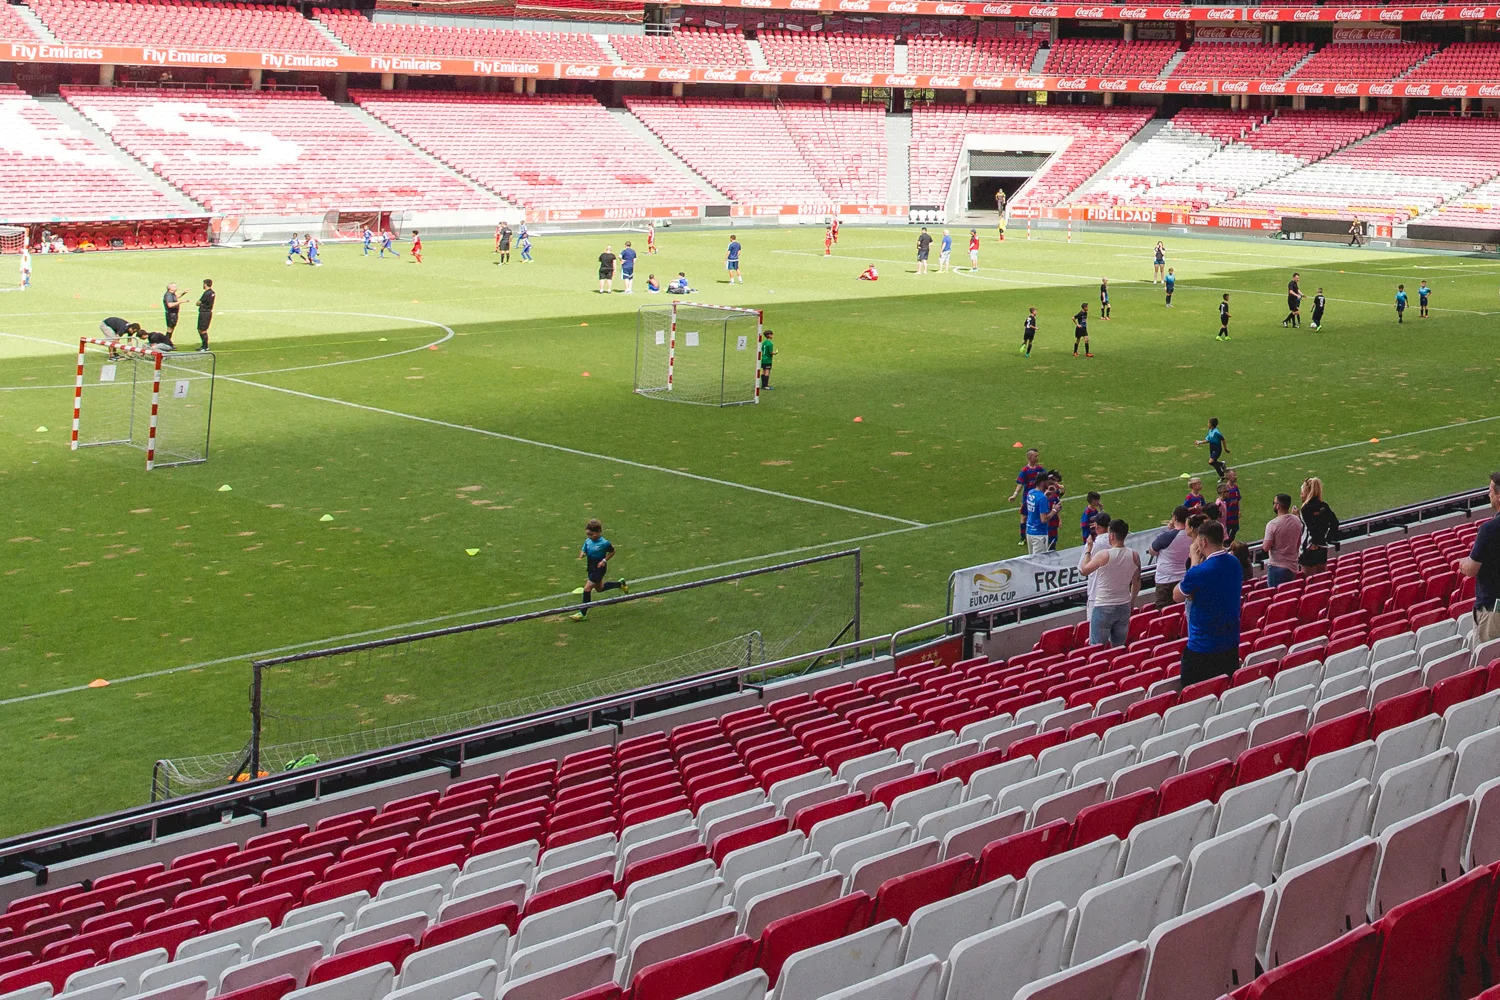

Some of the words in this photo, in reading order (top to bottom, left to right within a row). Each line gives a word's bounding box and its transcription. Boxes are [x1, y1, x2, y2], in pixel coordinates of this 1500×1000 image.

[11, 44, 36, 59] Fly
[38, 45, 102, 59] Emirates
[143, 49, 166, 64] Fly
[168, 50, 226, 64] Emirates
[262, 53, 284, 68] Fly
[284, 55, 338, 68] Emirates
[370, 57, 390, 71] Fly
[392, 59, 441, 72] Emirates
[473, 60, 492, 74] Fly
[494, 62, 539, 74] Emirates
[1088, 210, 1157, 222] FIDELIDADE
[179, 385, 183, 393] 1
[970, 594, 998, 607] EUROPA
[1000, 591, 1016, 601] CUP
